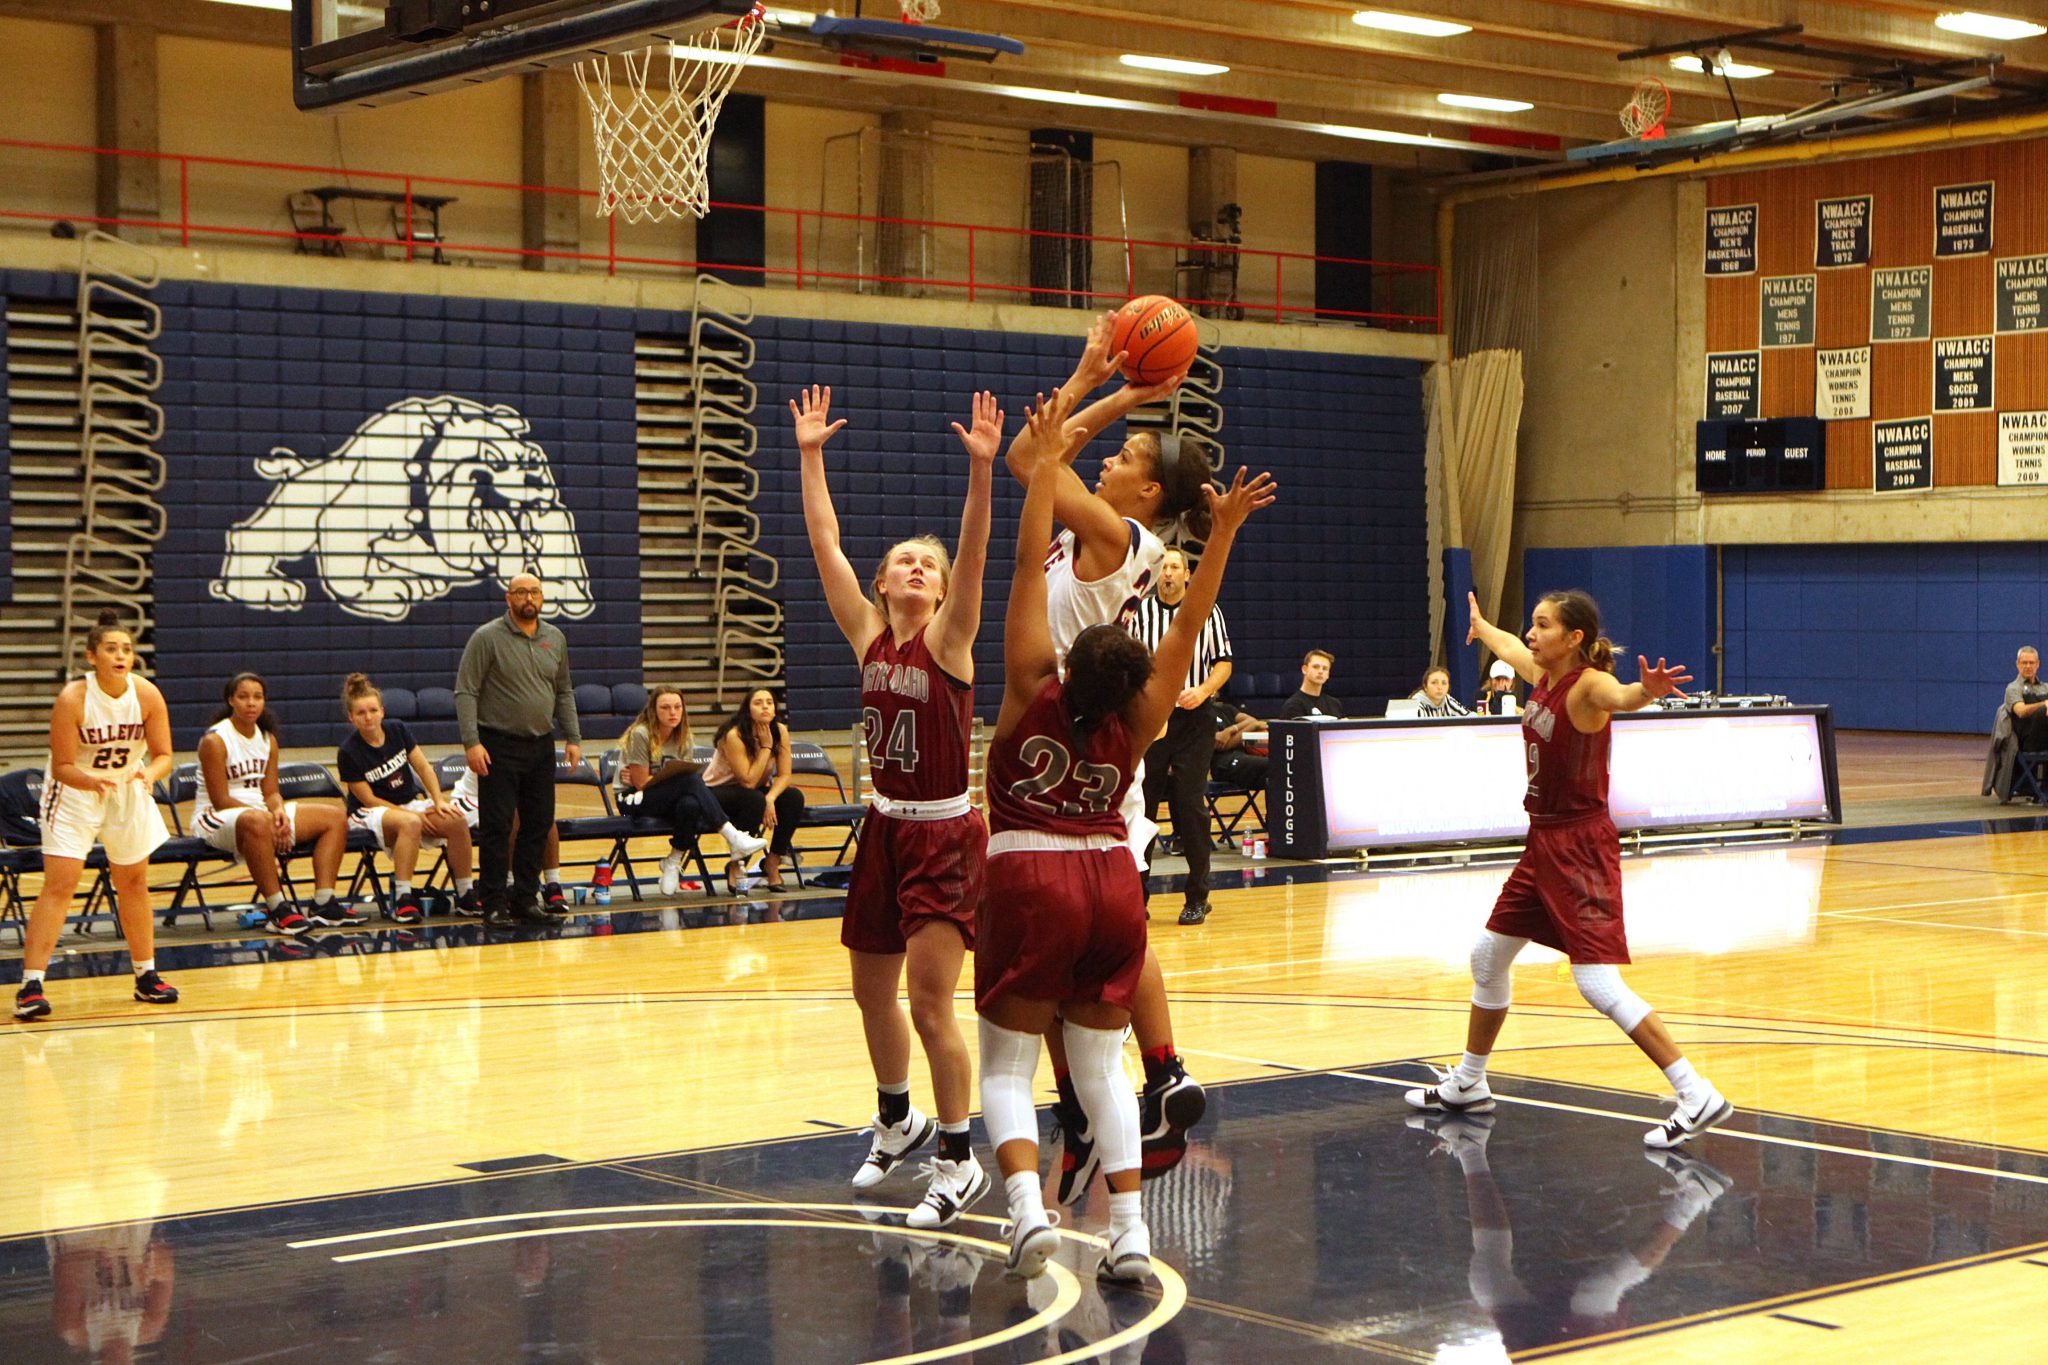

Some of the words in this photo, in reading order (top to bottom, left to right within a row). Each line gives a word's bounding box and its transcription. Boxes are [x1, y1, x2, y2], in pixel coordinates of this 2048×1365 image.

[1941, 190, 1987, 208] NWAACC
[1823, 202, 1866, 219] NWAACC
[1944, 209, 1984, 222] CHAMPION
[1711, 210, 1753, 226] NWAACC
[1825, 217, 1862, 229] CHAMPION
[1713, 225, 1748, 237] CHAMPION
[1942, 223, 1984, 236] BASEBALL
[1831, 240, 1855, 251] TRACK
[1953, 239, 1974, 251] 1973
[1708, 248, 1752, 259] BASKETBALL
[1834, 252, 1852, 263] 1972
[2000, 258, 2048, 277] NWAAC
[1877, 270, 1928, 287] NWAACC
[2005, 276, 2047, 290] CHAMPION
[1764, 279, 1813, 294] NWAACC
[1882, 288, 1921, 299] CHAMPION
[2014, 291, 2038, 302] MENS
[1769, 296, 1806, 307] CHAMPION
[1890, 301, 1912, 312] MENS
[1777, 309, 1798, 319] MENS
[2012, 304, 2040, 316] TENNIS
[1888, 314, 1915, 325] TENNIS
[2016, 317, 2037, 329] 1973
[1775, 321, 1800, 331] TENNIS
[1891, 327, 1911, 337] 1972
[1779, 334, 1796, 344] 1971
[1937, 339, 1990, 357] NWAACC
[1820, 350, 1868, 365] NWAACC
[1944, 357, 1983, 369] CHAMPION
[1711, 359, 1756, 373] NWAACC
[1825, 368, 1861, 378] CHAMPION
[1953, 371, 1974, 382] MENS
[1715, 376, 1751, 387] CHAMPION
[1828, 381, 1858, 391] WOMENS
[1715, 390, 1750, 401] BASEBALL
[1948, 384, 1978, 395] SOCCER
[1832, 394, 1856, 404] TENNIS
[1952, 397, 1974, 408] 2009
[1722, 404, 1743, 415] 2007
[1833, 406, 1854, 416] 2008
[2002, 413, 2048, 429] NWAAC
[1877, 424, 1928, 443] NWAACC
[2008, 432, 2048, 442] CHAMPION
[1705, 450, 1726, 461] HOME
[1746, 448, 1766, 457] PERIOD
[1784, 447, 1808, 458] GUEST
[1884, 444, 1922, 457] CHAMPION
[2012, 445, 2046, 455] WOMENS
[1885, 459, 1922, 472] BASEBALL
[2016, 458, 2042, 468] TENNIS
[1893, 474, 1915, 486] 2009
[2017, 472, 2040, 482] 2009
[862, 706, 919, 773] 24
[92, 747, 130, 769] 23
[365, 748, 407, 783] BULLDOG
[1008, 734, 1120, 815] 23
[1286, 734, 1294, 845] BULLDOGS
